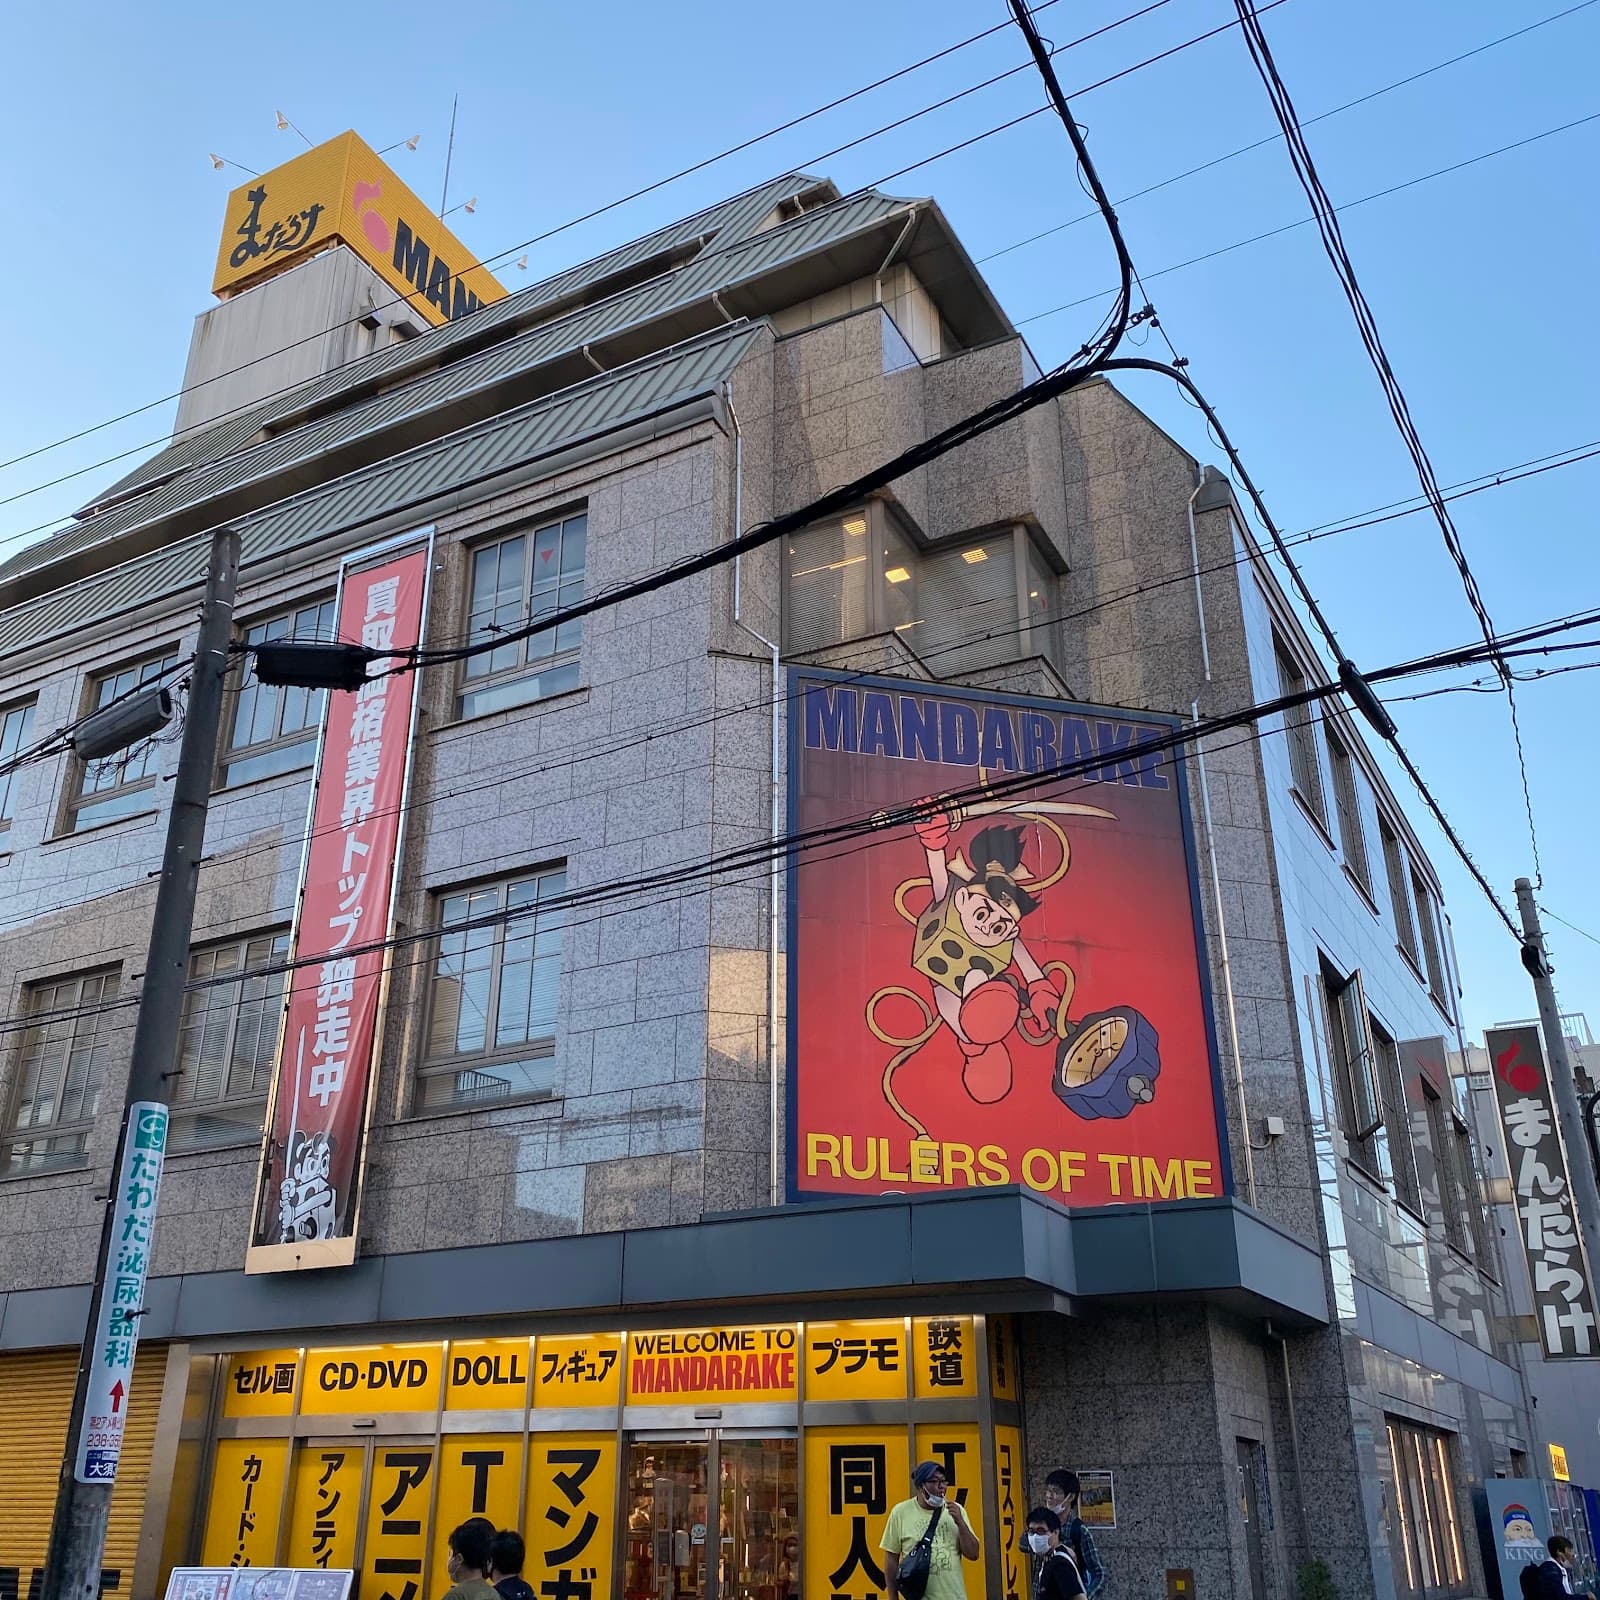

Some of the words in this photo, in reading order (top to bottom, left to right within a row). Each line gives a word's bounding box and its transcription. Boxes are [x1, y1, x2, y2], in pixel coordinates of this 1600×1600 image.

[392, 217, 486, 320] MAN
[803, 684, 1169, 790] MANDARAKE
[806, 1133, 1010, 1187] RULERS
[1020, 1147, 1087, 1193] OF
[1098, 1153, 1215, 1199] TIME
[1503, 1097, 1595, 1356] まんだらけ
[104, 1152, 156, 1368] たわだ泌尿器科
[541, 1349, 618, 1384] フィギュア
[634, 1330, 755, 1355] WELCOME
[761, 1328, 795, 1350] TO
[811, 1338, 899, 1375] プラモ
[927, 1316, 965, 1387] 鉄道
[233, 1362, 297, 1395] セル画
[452, 1354, 527, 1386] DOLL
[632, 1352, 795, 1394] MANDARAKE
[828, 1444, 888, 1600] 同人
[1504, 1547, 1545, 1561] KING
